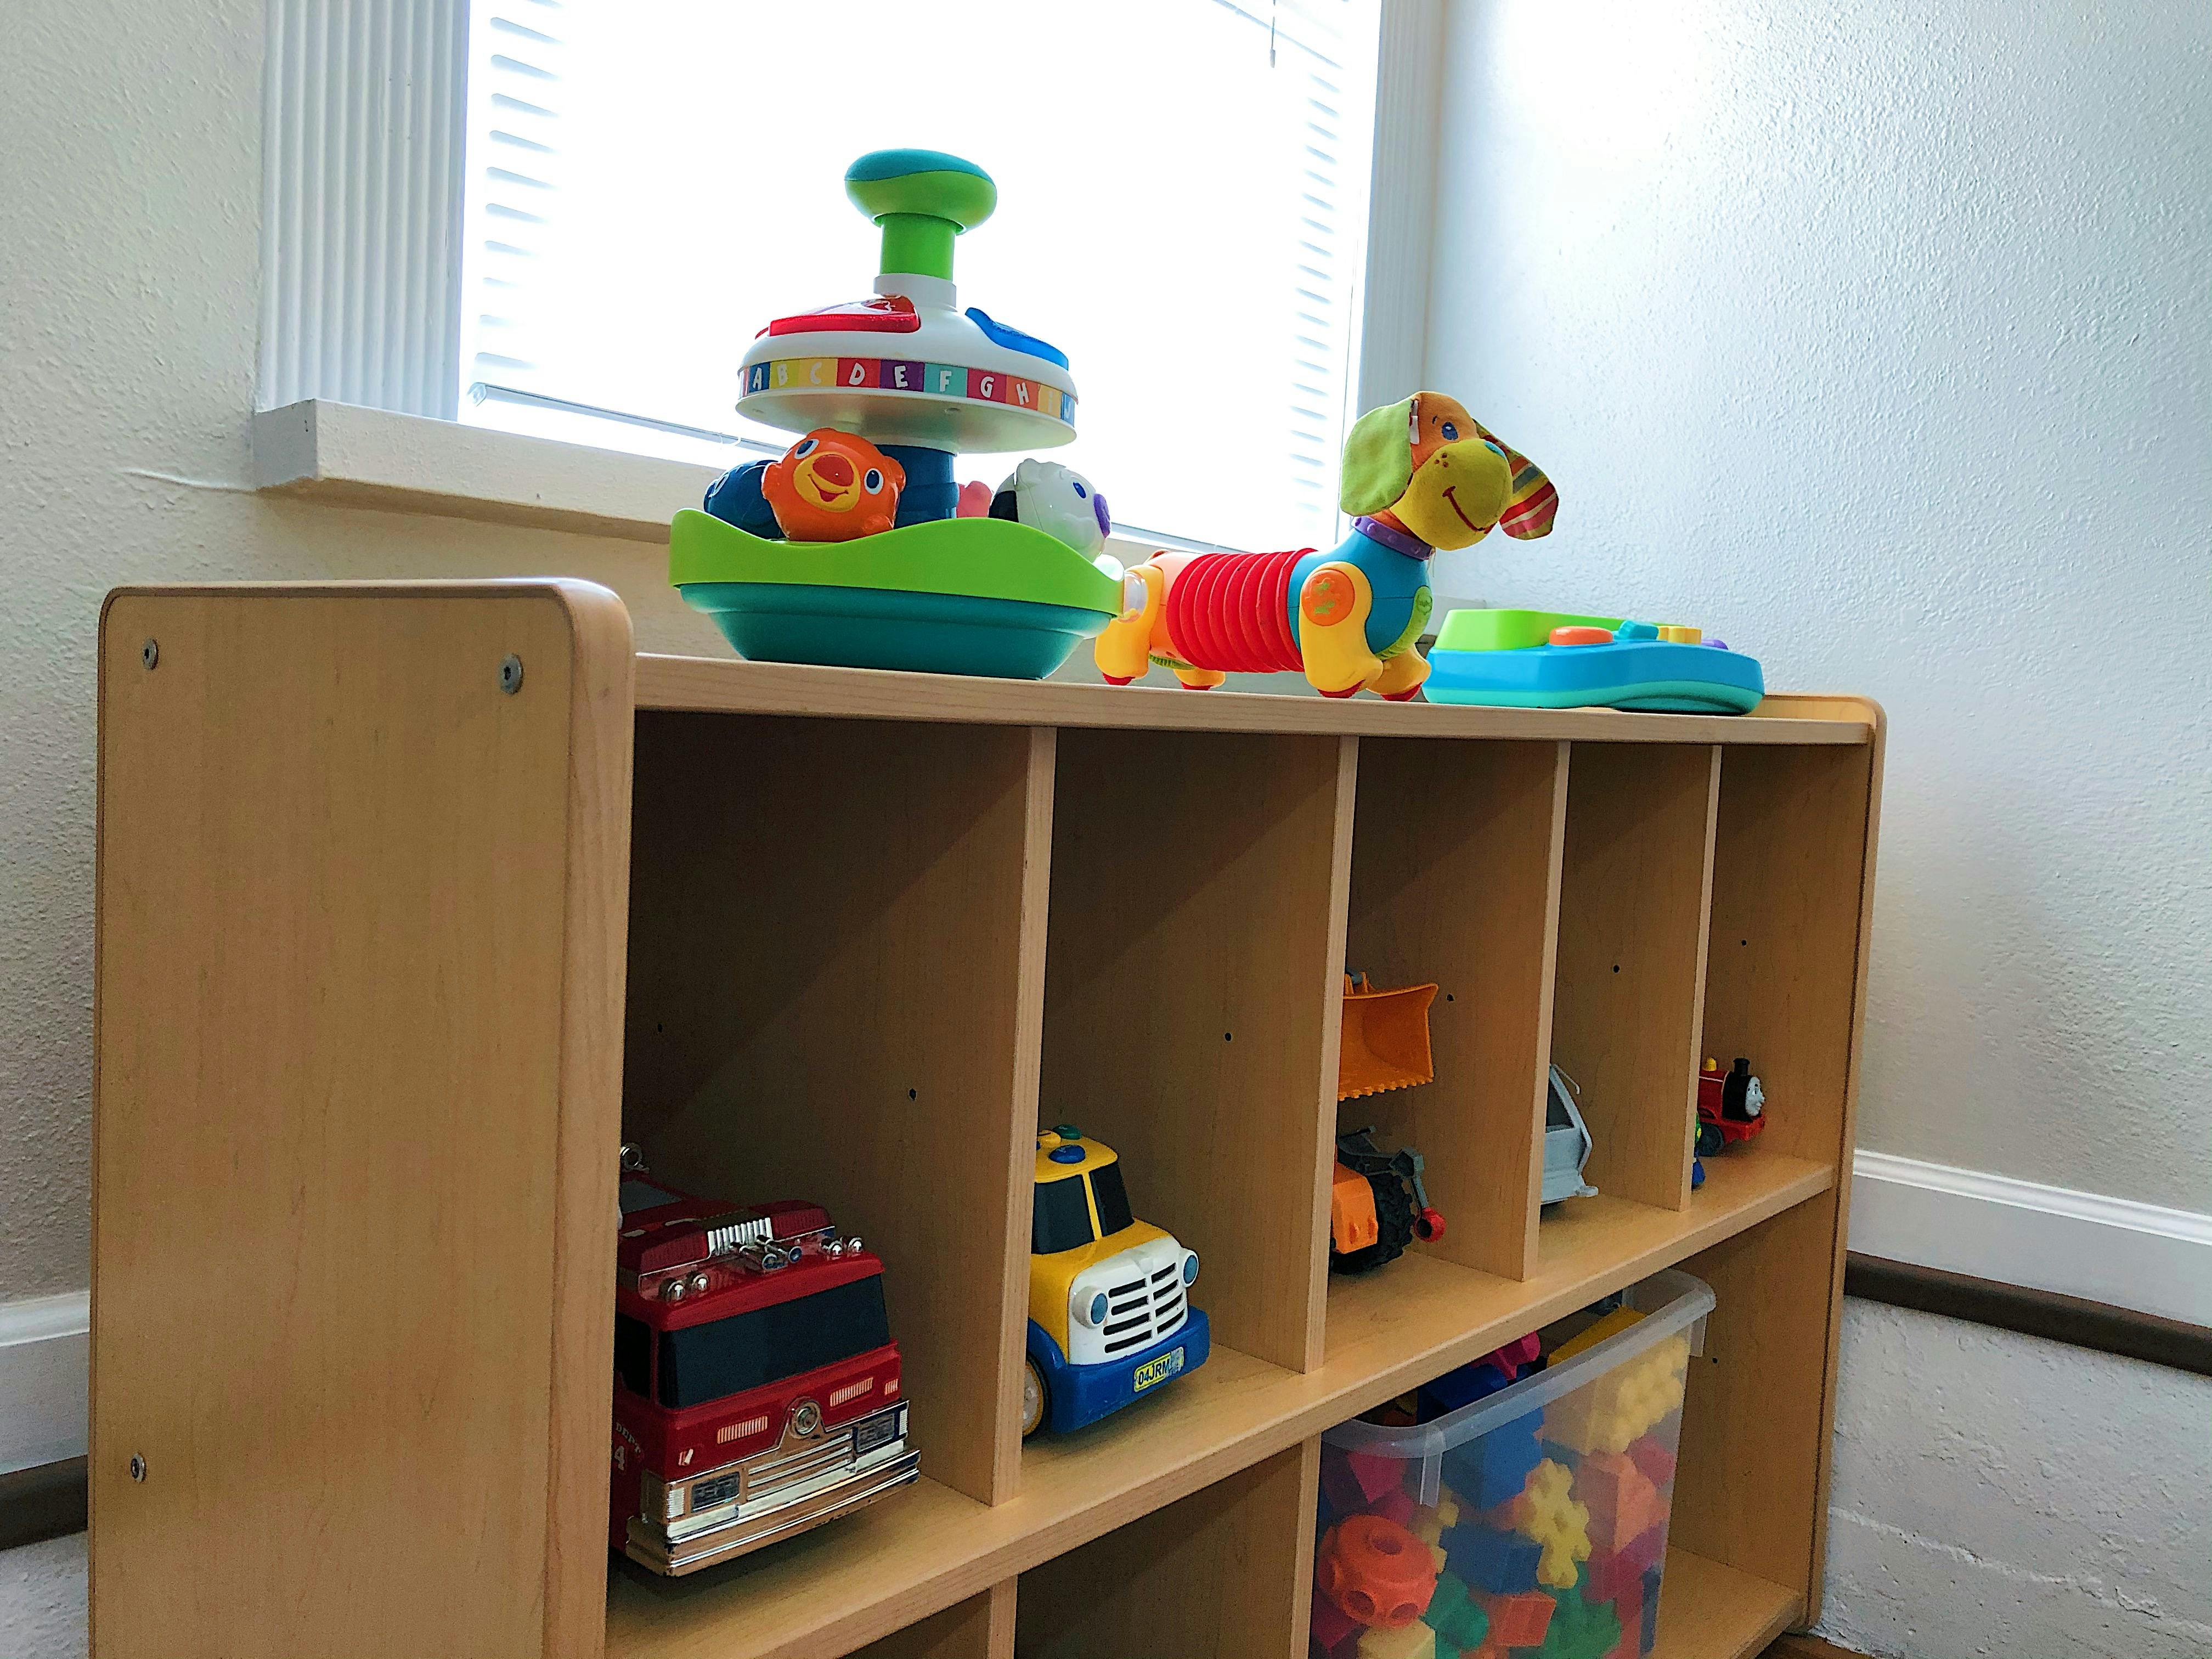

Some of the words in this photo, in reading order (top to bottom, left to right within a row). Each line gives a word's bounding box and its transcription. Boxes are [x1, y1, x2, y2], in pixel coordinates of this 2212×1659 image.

[753, 367, 762, 390] A
[777, 364, 788, 386] B
[810, 362, 822, 385] C
[849, 362, 865, 386] D
[894, 365, 909, 388] E
[940, 370, 952, 392] F
[980, 376, 995, 398] G
[1015, 382, 1030, 405] H
[614, 1446, 625, 1470] 4
